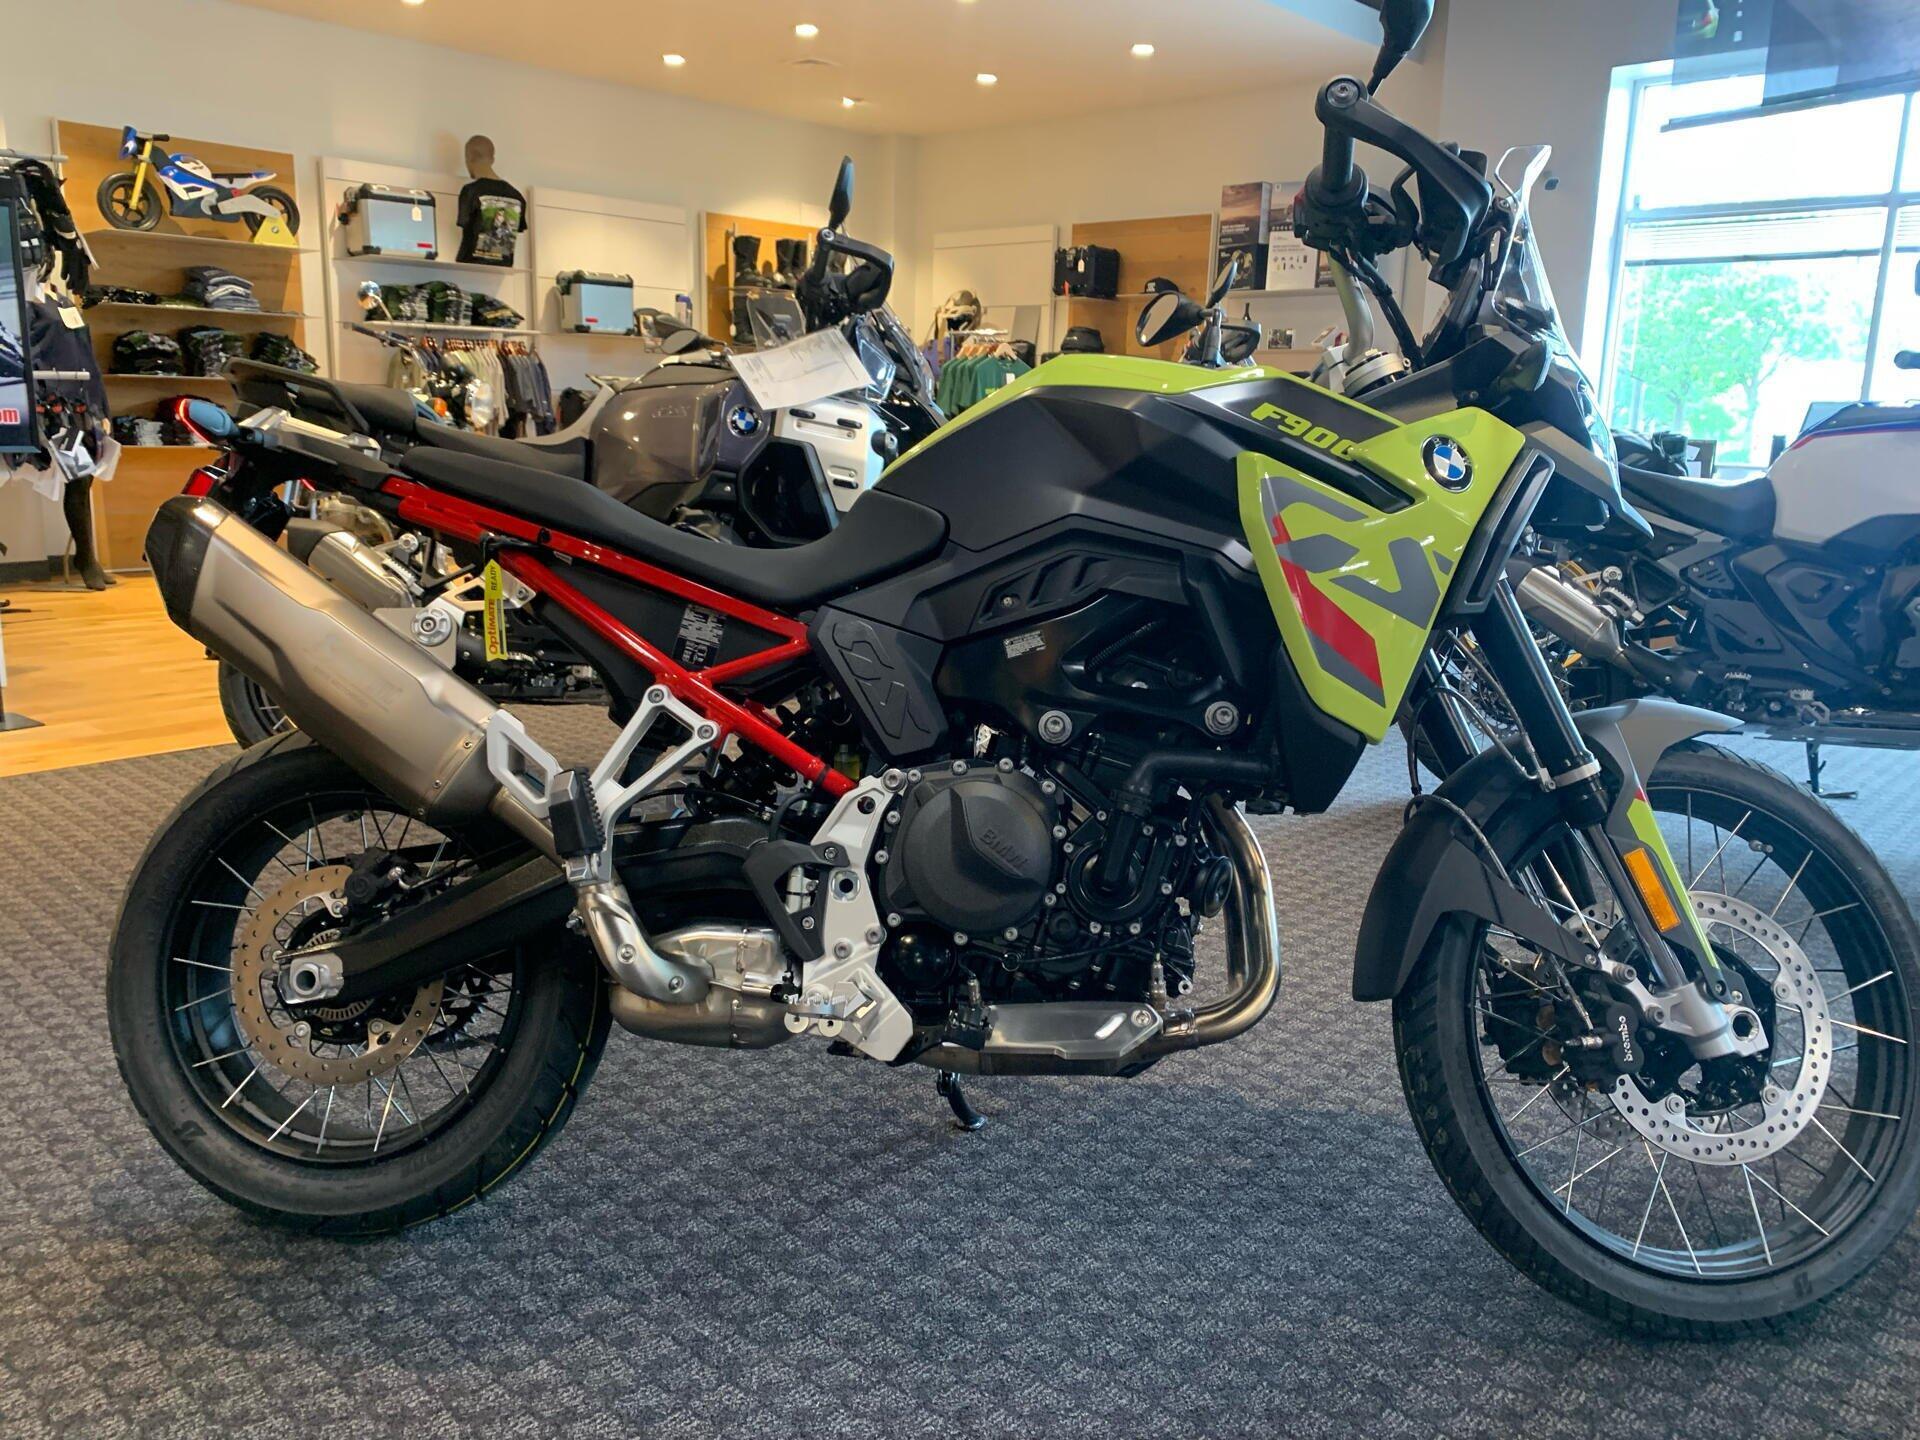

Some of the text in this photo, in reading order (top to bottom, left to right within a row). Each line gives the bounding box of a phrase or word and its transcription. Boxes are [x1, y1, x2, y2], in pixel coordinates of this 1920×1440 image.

[490, 565, 498, 591] READY
[979, 828, 1029, 870] BMW
[1618, 1015, 1634, 1062] brembo
